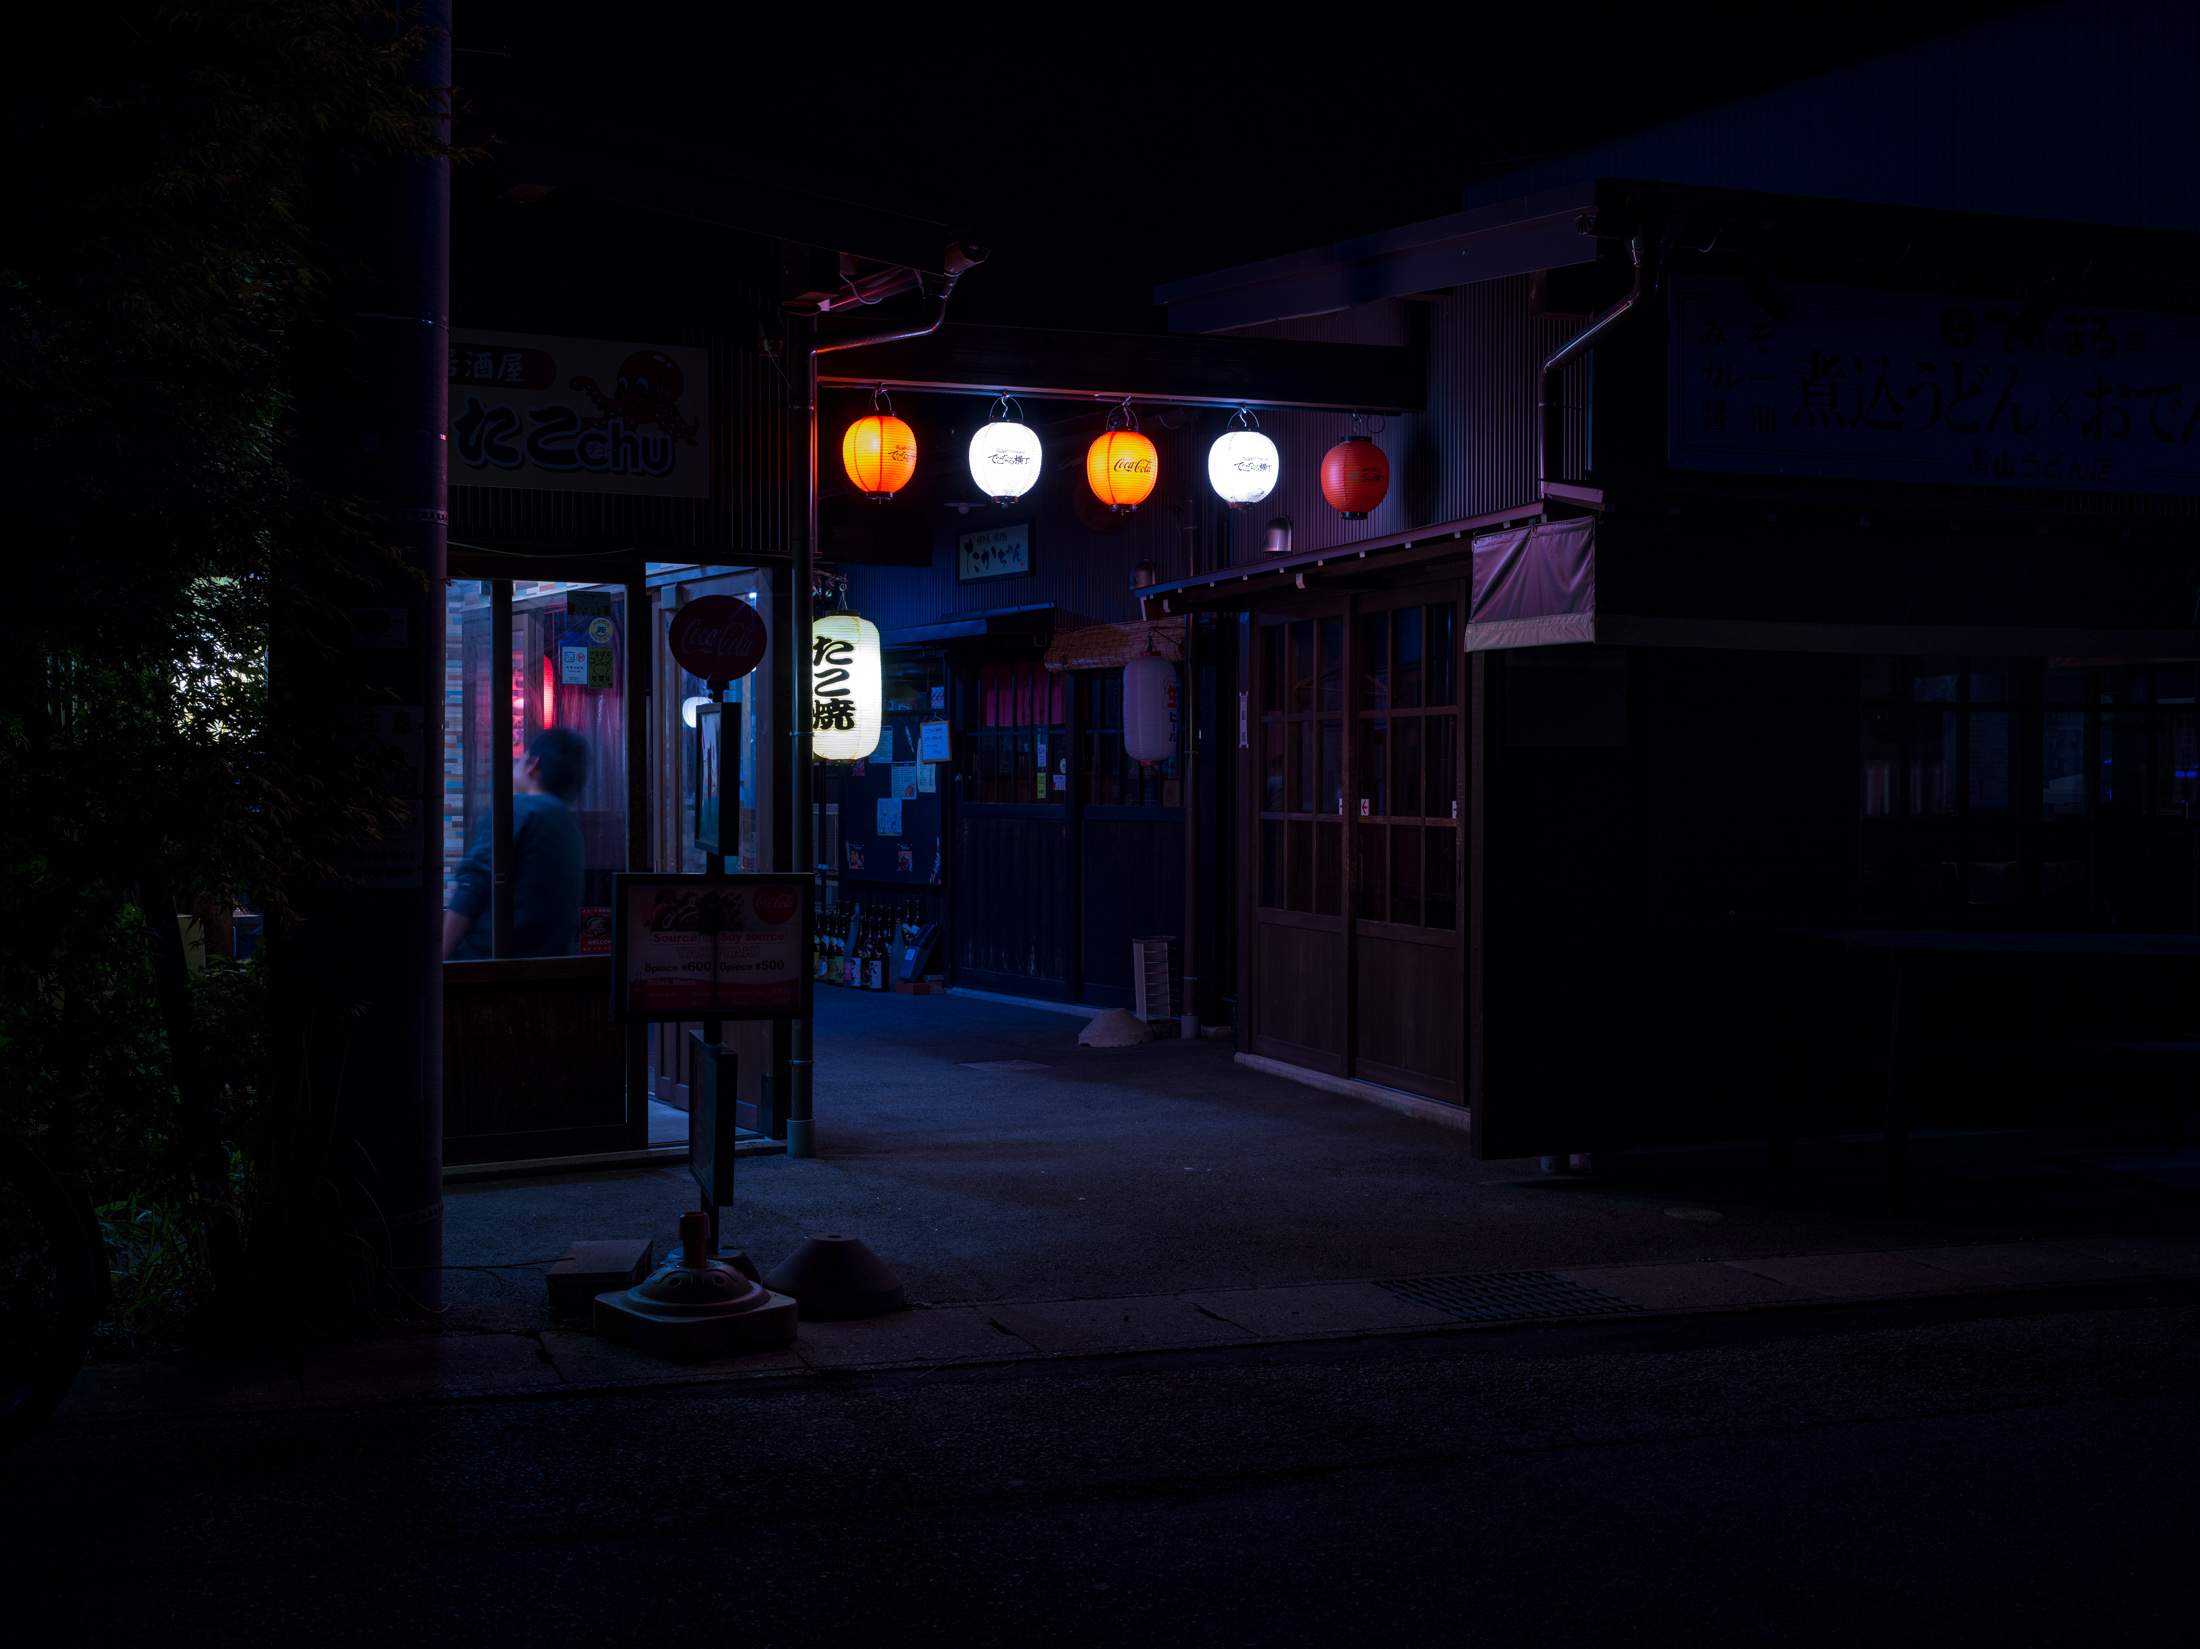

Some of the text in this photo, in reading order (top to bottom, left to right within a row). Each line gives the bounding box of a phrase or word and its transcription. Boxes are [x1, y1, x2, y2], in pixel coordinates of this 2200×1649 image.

[1699, 319, 1775, 354] みそ
[1700, 359, 1776, 389] カレー
[1701, 399, 1777, 434] 醤油
[1967, 446, 2114, 483] 高山うどん店
[680, 618, 758, 657] Coca-Cola
[812, 635, 857, 731] たこ焼
[653, 933, 698, 943] Source
[720, 932, 742, 944] Soy
[745, 932, 785, 941] source
[675, 945, 761, 959] TAKOYAKI
[644, 960, 785, 972] 8piece ¥600 6piece ¥500
[648, 978, 696, 986] Drink Menu
